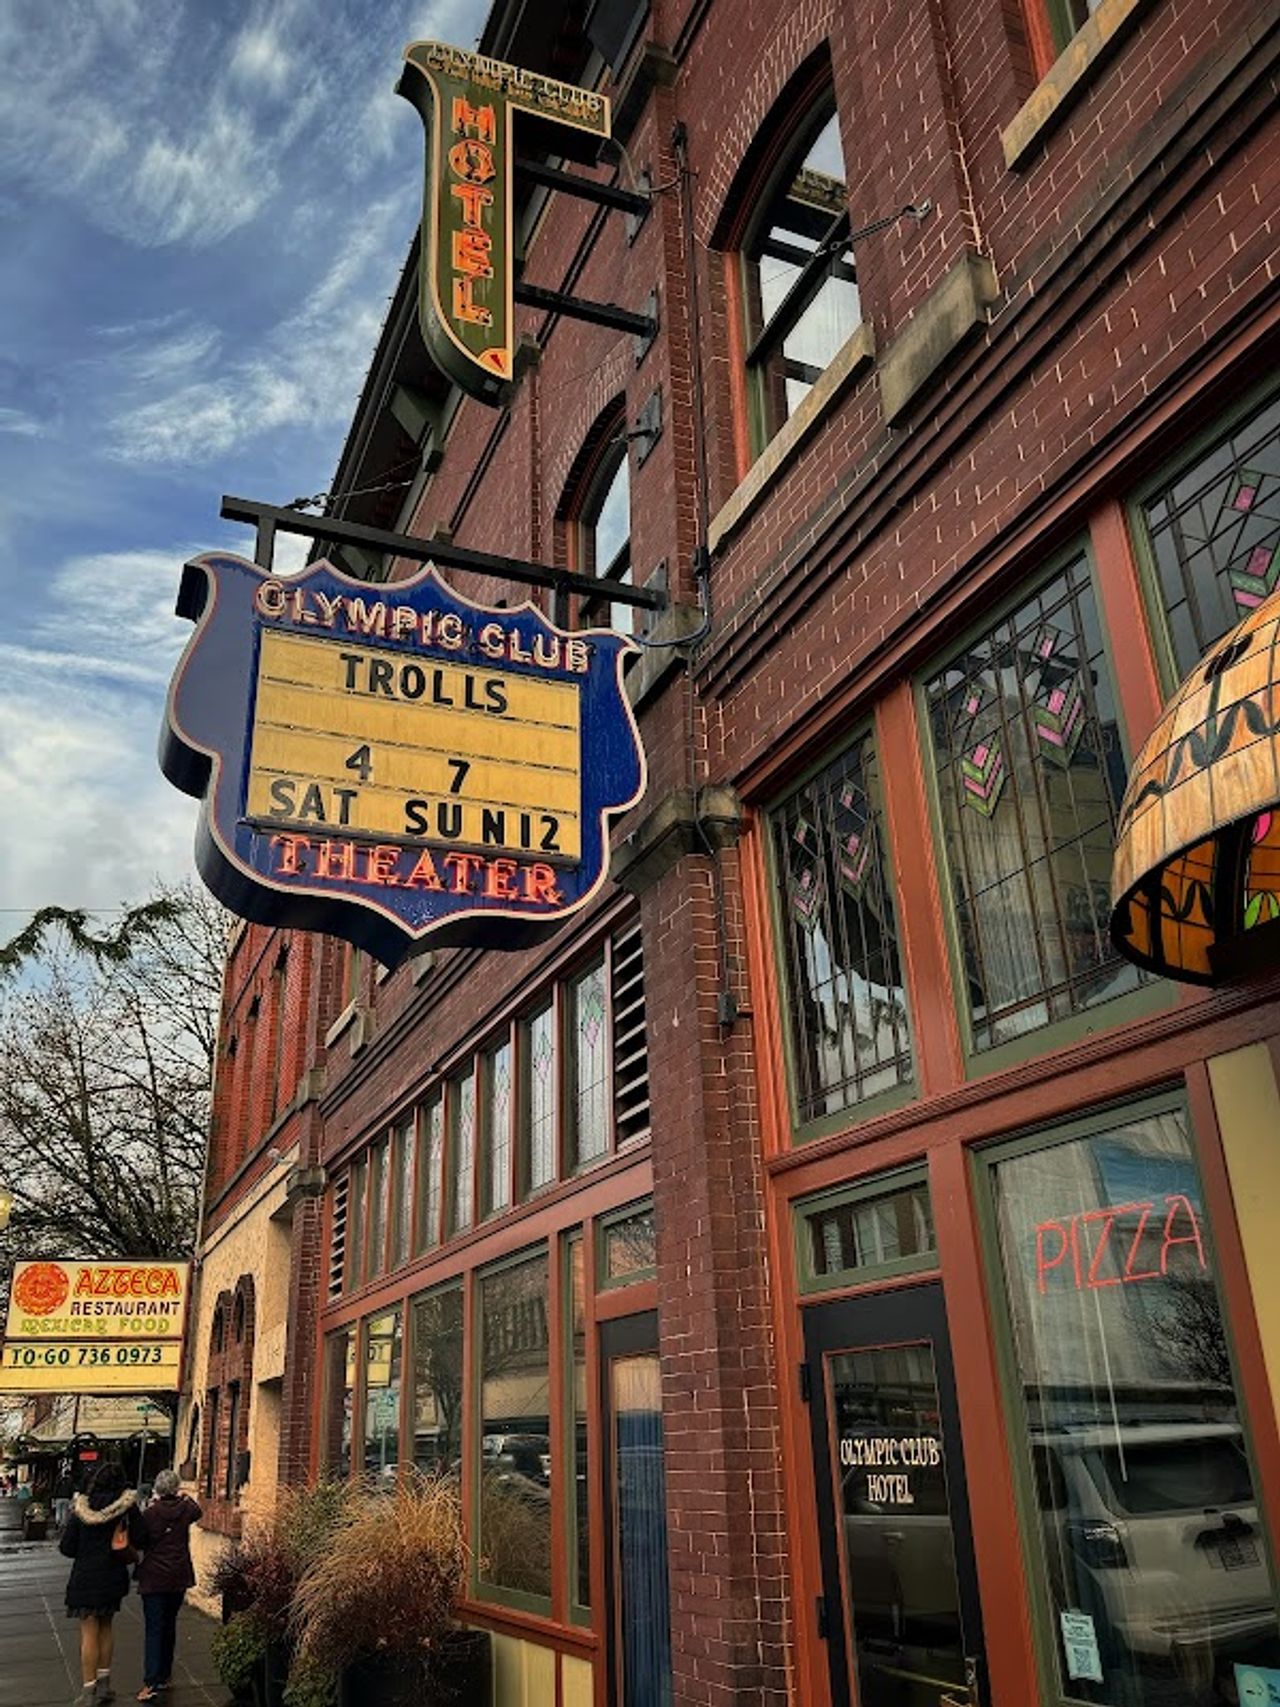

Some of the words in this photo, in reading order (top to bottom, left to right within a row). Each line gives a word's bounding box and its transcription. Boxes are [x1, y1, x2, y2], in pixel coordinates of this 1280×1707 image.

[426, 44, 533, 100] OLYMPIC
[537, 80, 602, 124] CLUB
[449, 95, 496, 327] HOTEL
[253, 579, 465, 650] OLYMPIC
[477, 622, 590, 673] CLUB
[340, 652, 508, 714] TROLLS
[345, 744, 373, 781] 4
[448, 758, 470, 794] 7
[268, 780, 358, 825] SAT
[269, 832, 563, 905] THEATER
[1035, 1194, 1207, 1295] PIZZA
[73, 1266, 181, 1297] AZTECA
[70, 1301, 180, 1316] RESTAURANT
[118, 1318, 170, 1333] FOOD
[78, 1348, 110, 1365] 736
[116, 1348, 162, 1364] 0973
[840, 1438, 899, 1465] OLYMPIC
[900, 1438, 940, 1466] CLUB
[866, 1474, 914, 1503] HOTEL
